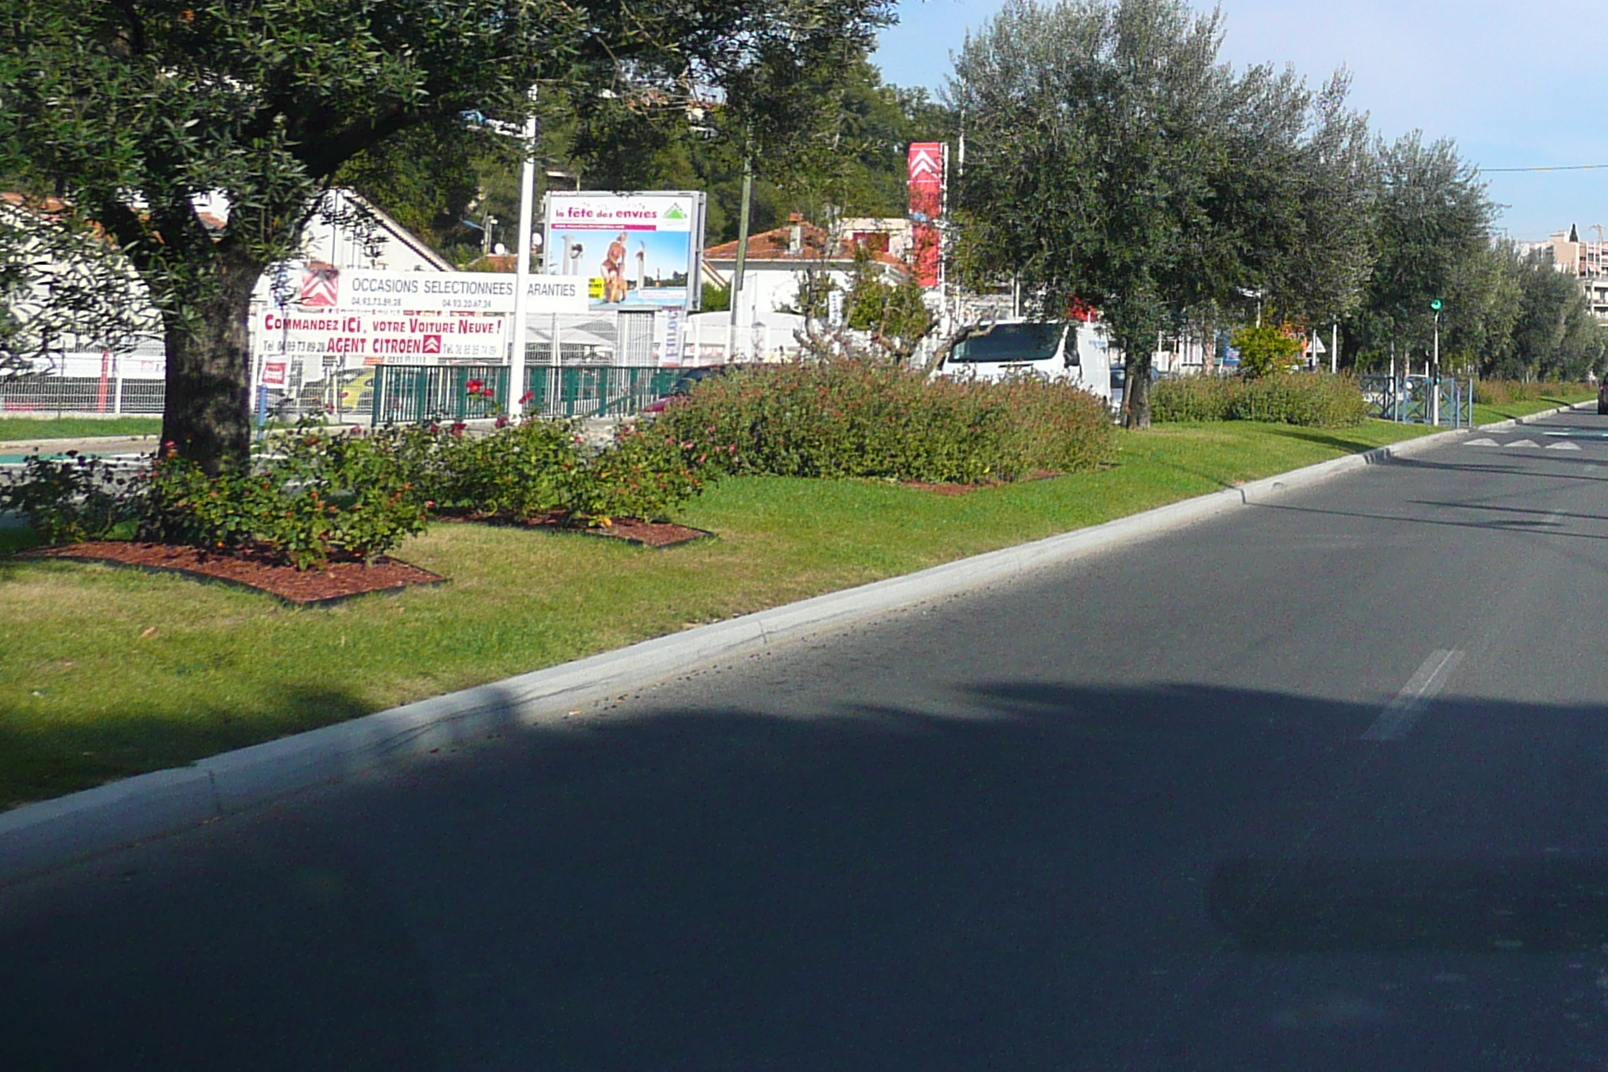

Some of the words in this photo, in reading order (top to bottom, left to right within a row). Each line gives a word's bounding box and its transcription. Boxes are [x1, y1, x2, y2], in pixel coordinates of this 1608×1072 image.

[555, 209, 564, 218] la
[568, 207, 593, 218] fête
[596, 210, 613, 218] des
[616, 210, 657, 219] envies
[352, 277, 419, 293] OCCASIONS
[424, 280, 513, 296] SELECTIONNEES
[527, 283, 576, 297] ARANTIES
[373, 321, 406, 333] VOTRE
[409, 318, 455, 334] VOITURE
[326, 337, 367, 353] AGENT
[372, 336, 421, 354] CITROËN
